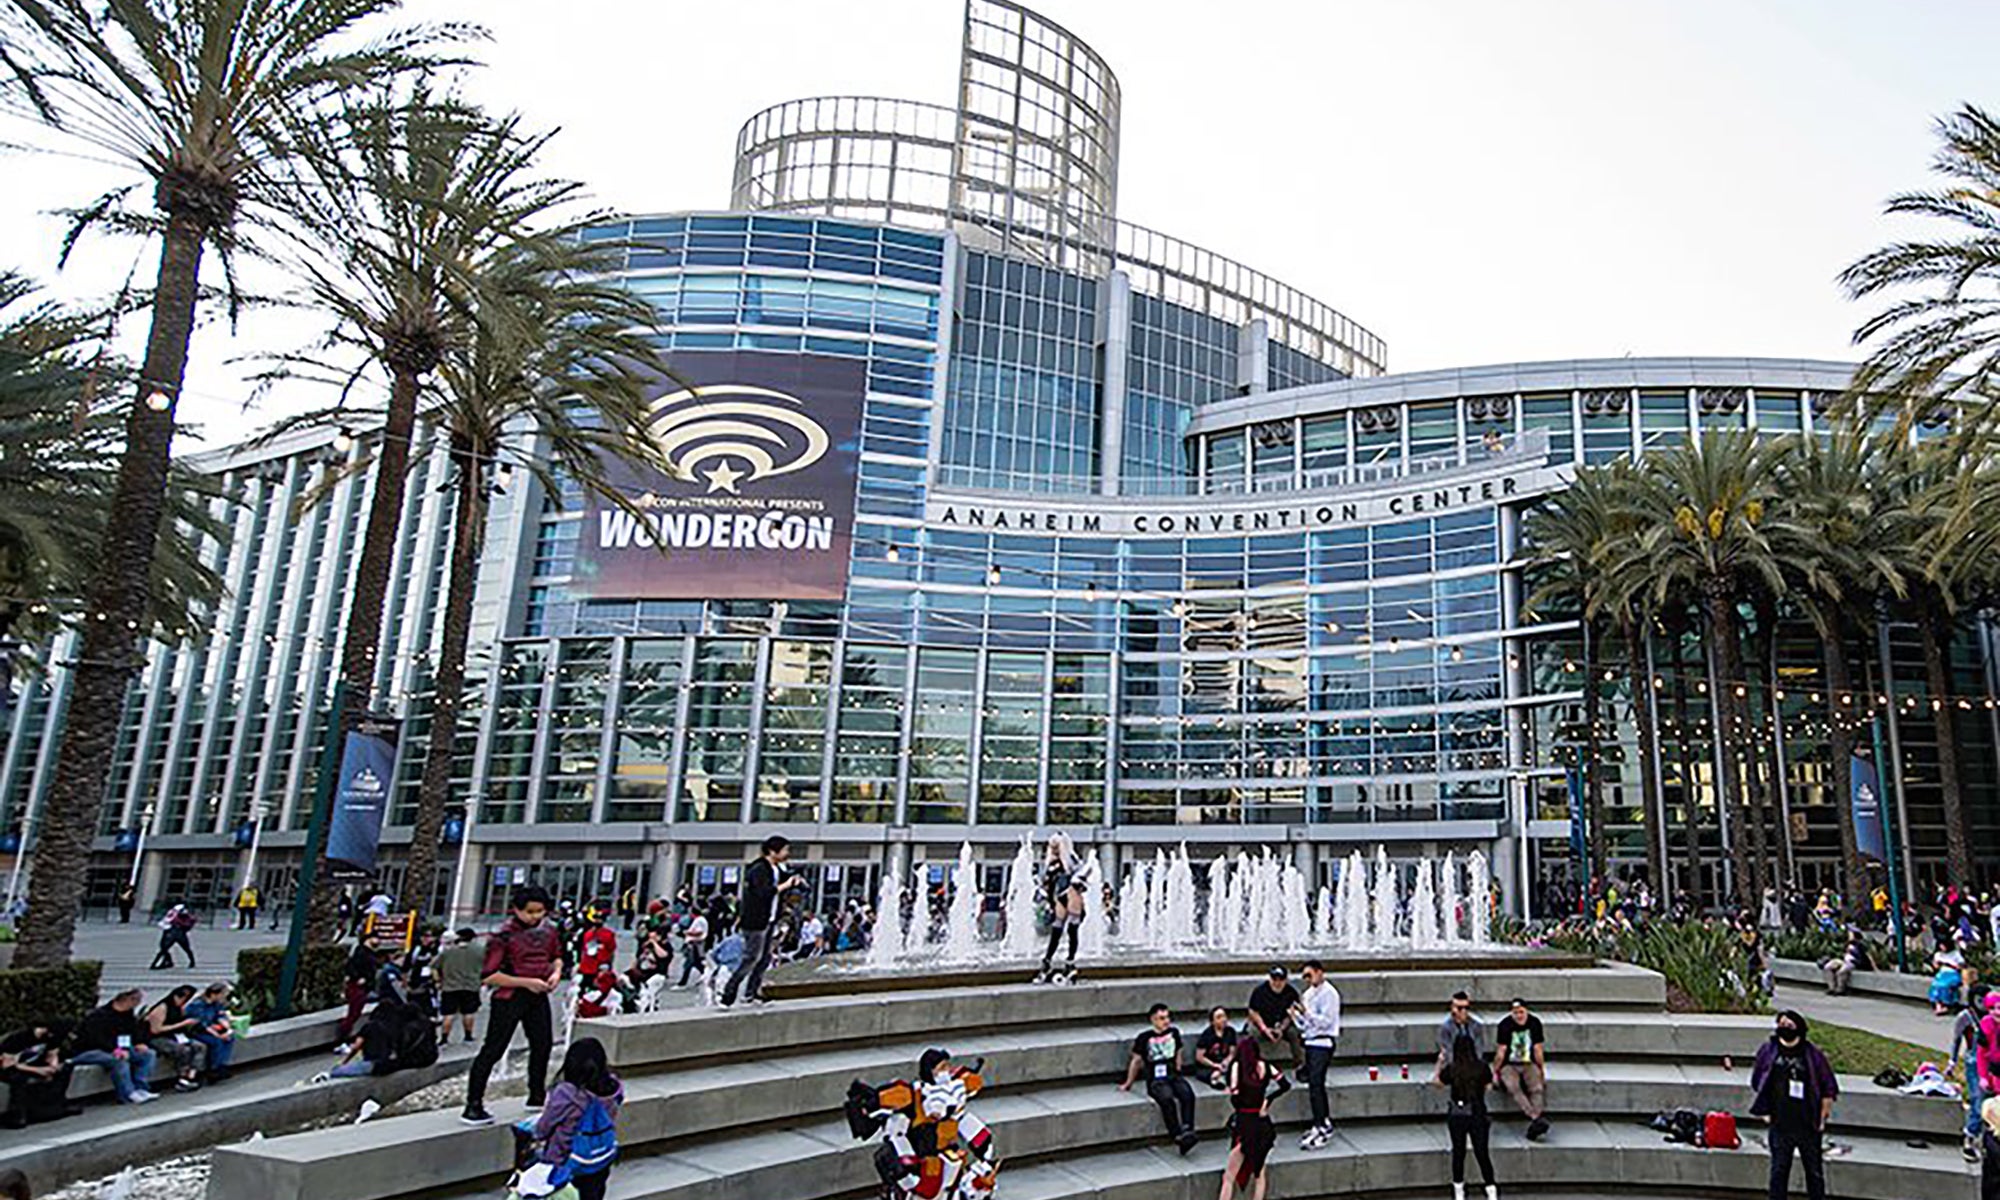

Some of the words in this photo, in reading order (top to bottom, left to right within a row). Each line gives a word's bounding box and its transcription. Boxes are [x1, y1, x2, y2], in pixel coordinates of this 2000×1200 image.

[677, 497, 766, 509] INTERNATIONAL
[768, 498, 825, 510] PRESENTS
[942, 506, 1101, 532] ANAHEIM
[1134, 504, 1358, 533] CONVENTION
[1389, 477, 1517, 515] CENTER
[600, 510, 834, 549] WONDERCON
